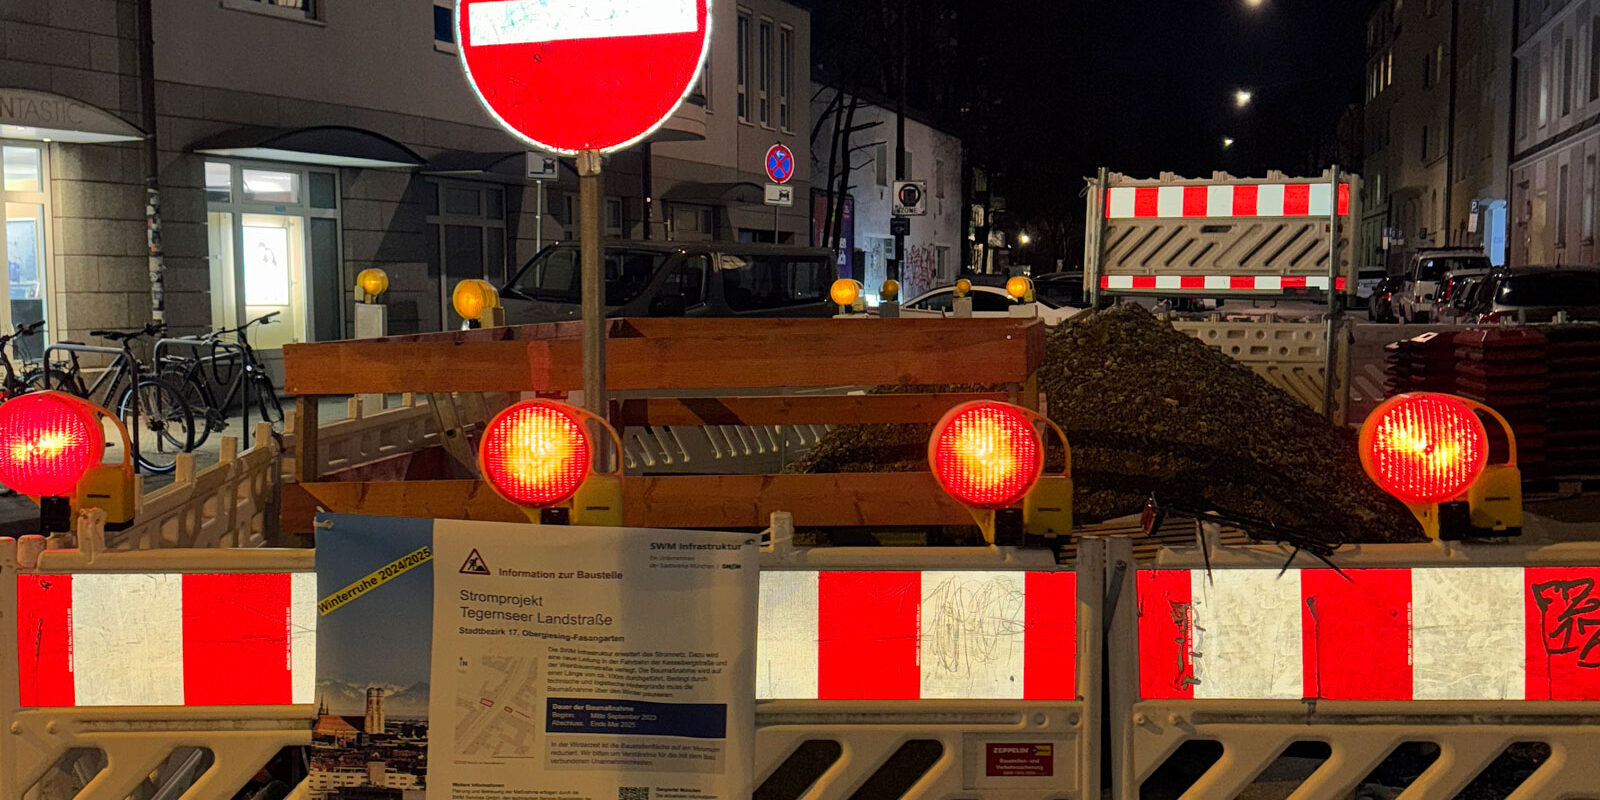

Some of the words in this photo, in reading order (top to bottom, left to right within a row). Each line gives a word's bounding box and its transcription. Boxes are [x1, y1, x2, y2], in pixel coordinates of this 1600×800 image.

[679, 542, 742, 551] Infrastruktur
[318, 576, 379, 613] Winterruhe
[378, 547, 432, 581] 2024/2025
[498, 568, 556, 579] Information
[557, 571, 575, 580] zur
[576, 570, 624, 580] Baustelle
[459, 589, 544, 608] Stromprojekt
[460, 606, 534, 623] Tegernseer
[537, 612, 613, 626] Landstraße
[458, 627, 506, 636] Stadtbezirk
[521, 630, 625, 643] Obergiesing-Fasangarten
